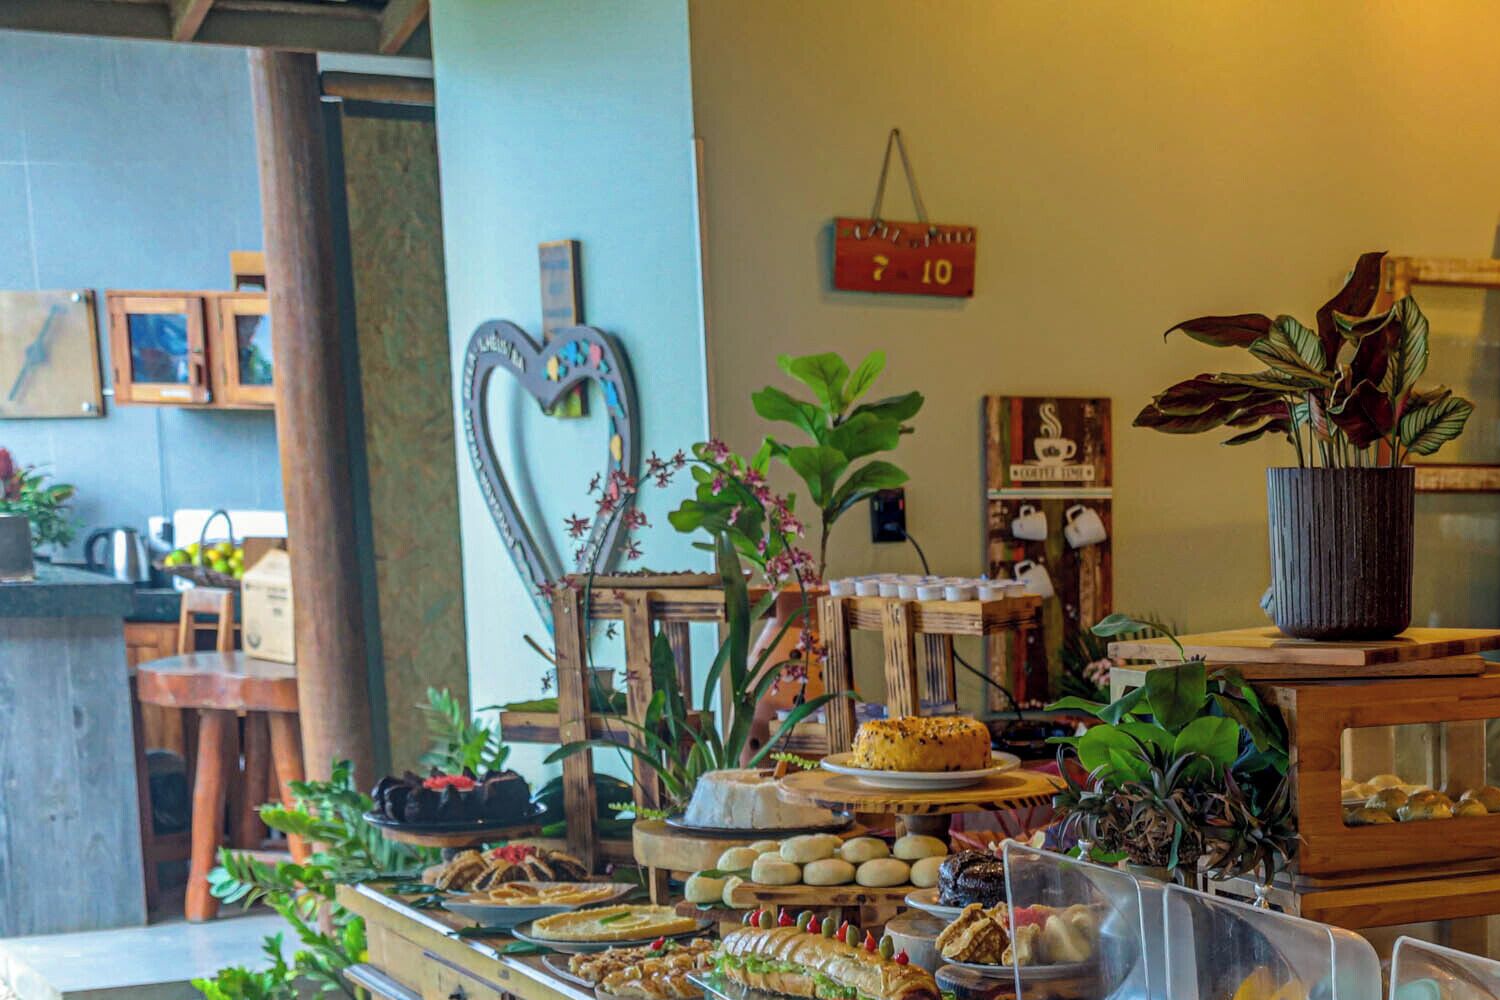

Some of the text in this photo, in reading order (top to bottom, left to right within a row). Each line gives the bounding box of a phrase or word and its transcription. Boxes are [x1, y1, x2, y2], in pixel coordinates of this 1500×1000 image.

[872, 255, 952, 285] 7 10
[1019, 466, 1085, 479] COFFEE TIME
